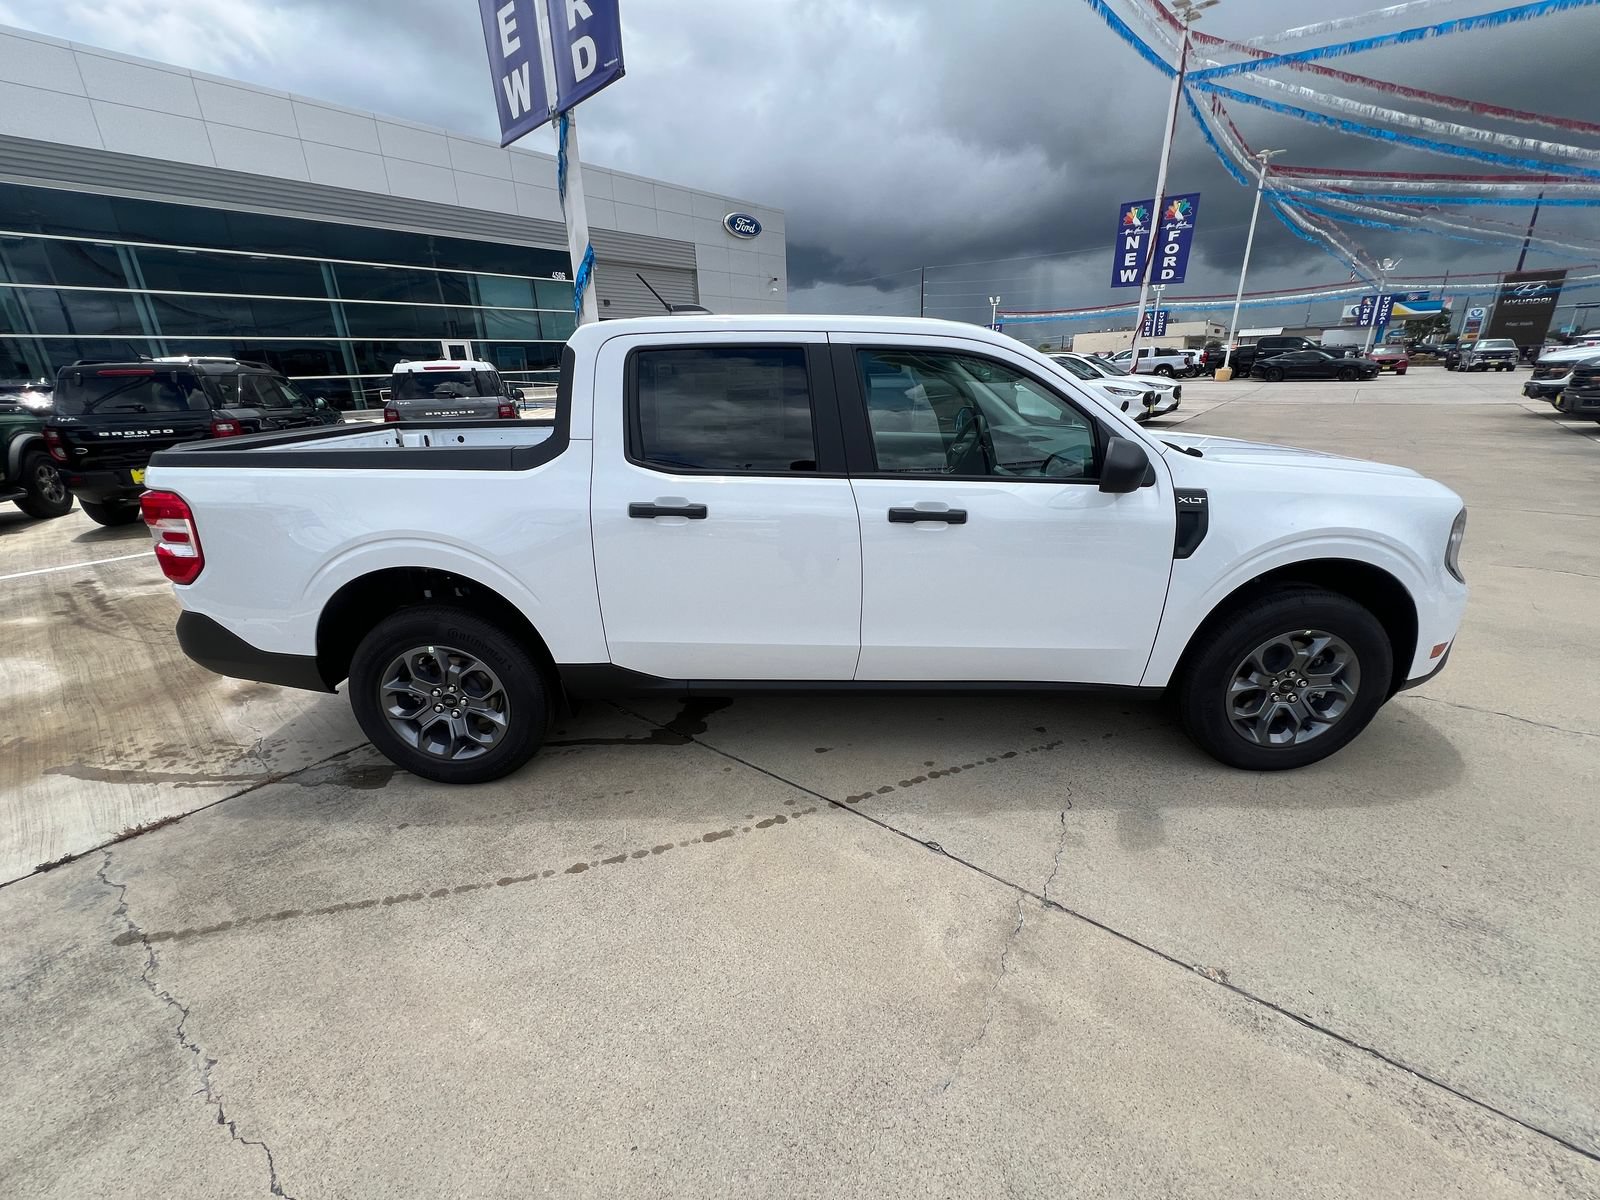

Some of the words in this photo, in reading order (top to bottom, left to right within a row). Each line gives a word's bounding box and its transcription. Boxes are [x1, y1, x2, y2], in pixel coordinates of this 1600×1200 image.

[735, 217, 756, 233] Ford
[1120, 235, 1140, 283] NEW
[1160, 230, 1181, 280] FORD
[1503, 297, 1552, 305] HYUNDAI
[1360, 307, 1370, 325] NEW
[1378, 296, 1391, 325] HYUNDAI
[1178, 496, 1207, 504] XLT
